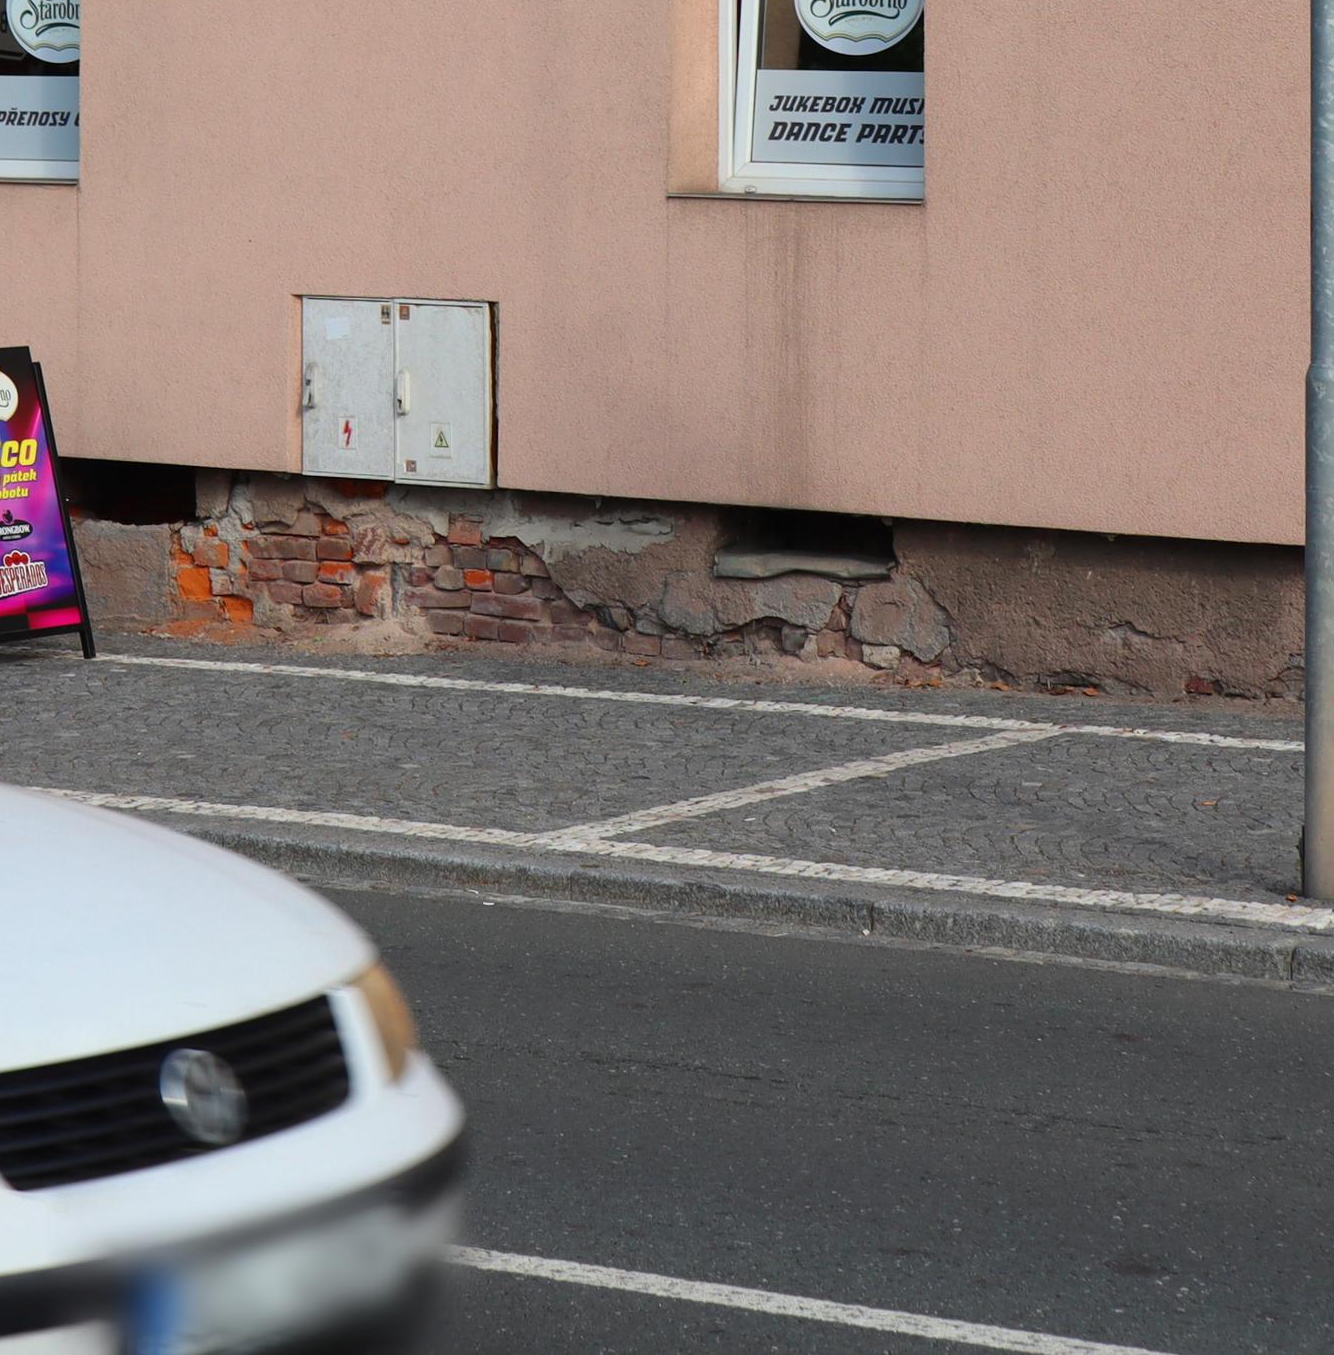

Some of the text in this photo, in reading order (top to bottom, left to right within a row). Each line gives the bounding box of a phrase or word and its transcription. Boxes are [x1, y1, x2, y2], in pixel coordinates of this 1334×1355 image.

[769, 95, 866, 114] JUKEBOX
[768, 121, 924, 145] DANCE PART
[2, 469, 37, 487] pátek
